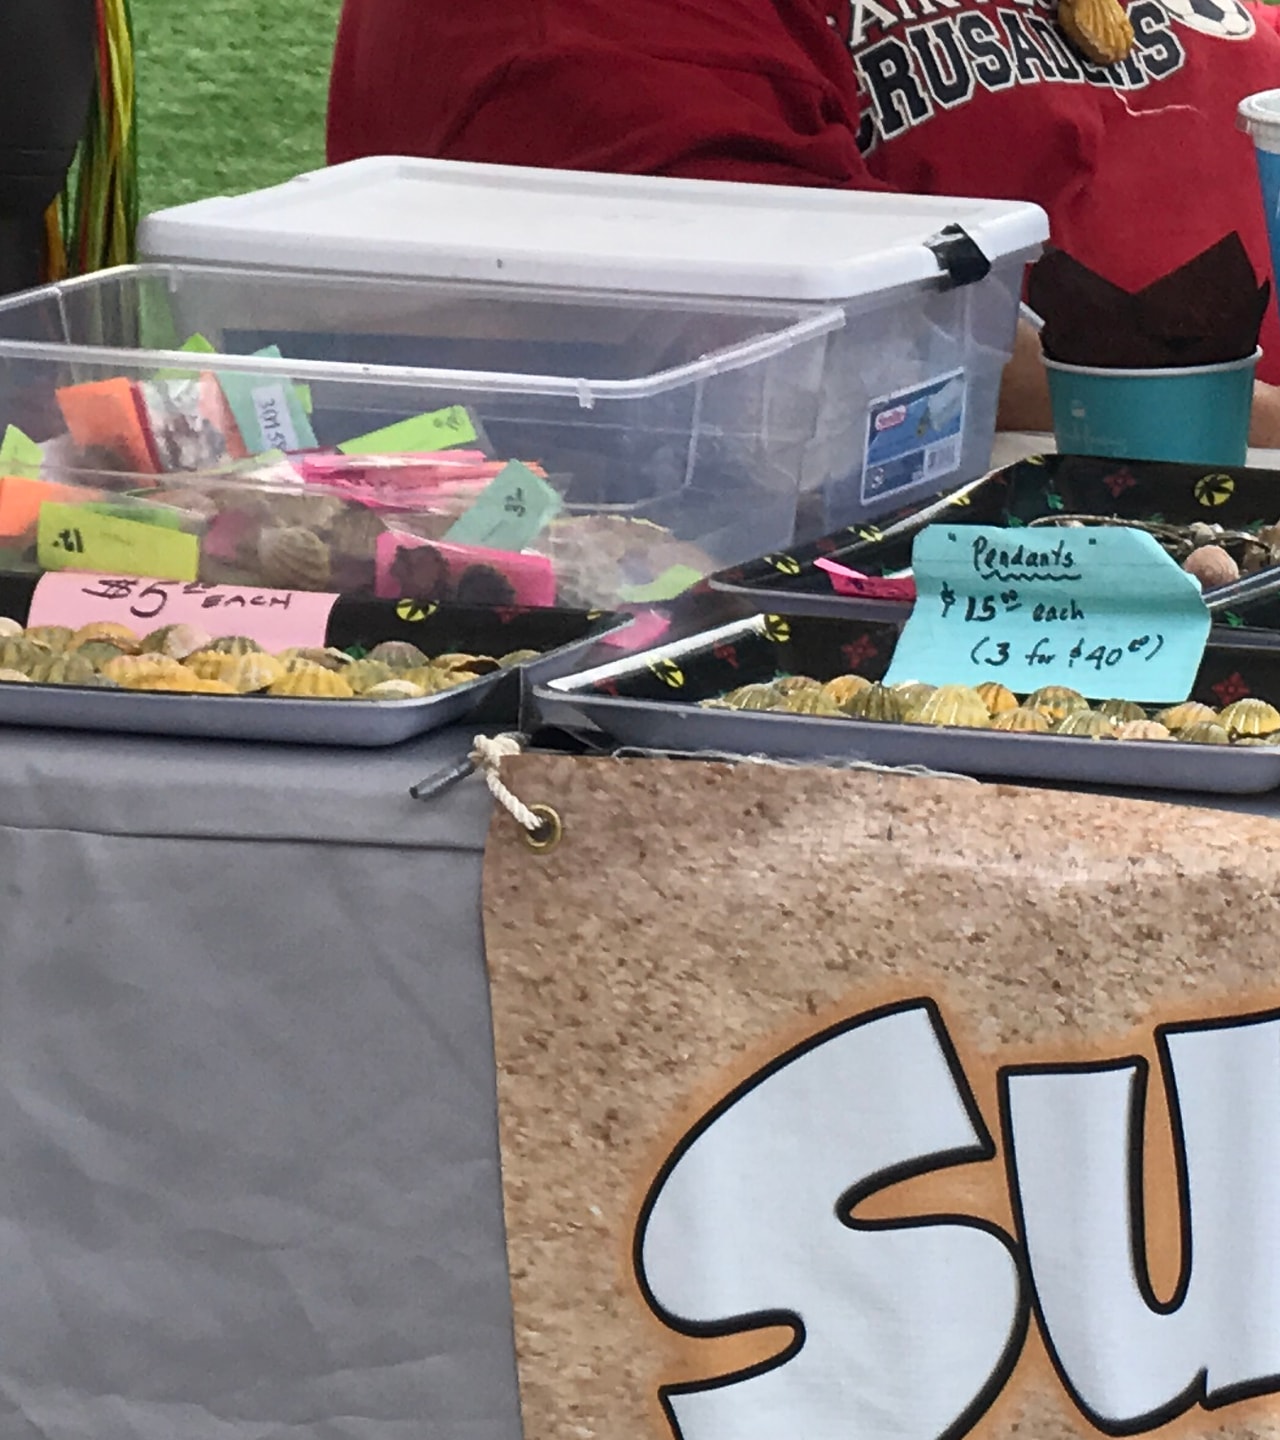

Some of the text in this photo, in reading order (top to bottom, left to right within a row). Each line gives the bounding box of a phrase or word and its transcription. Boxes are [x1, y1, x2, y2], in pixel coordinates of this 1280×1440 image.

[202, 593, 292, 610] EACH
[1033, 600, 1084, 622] each
[1025, 637, 1056, 666] for
